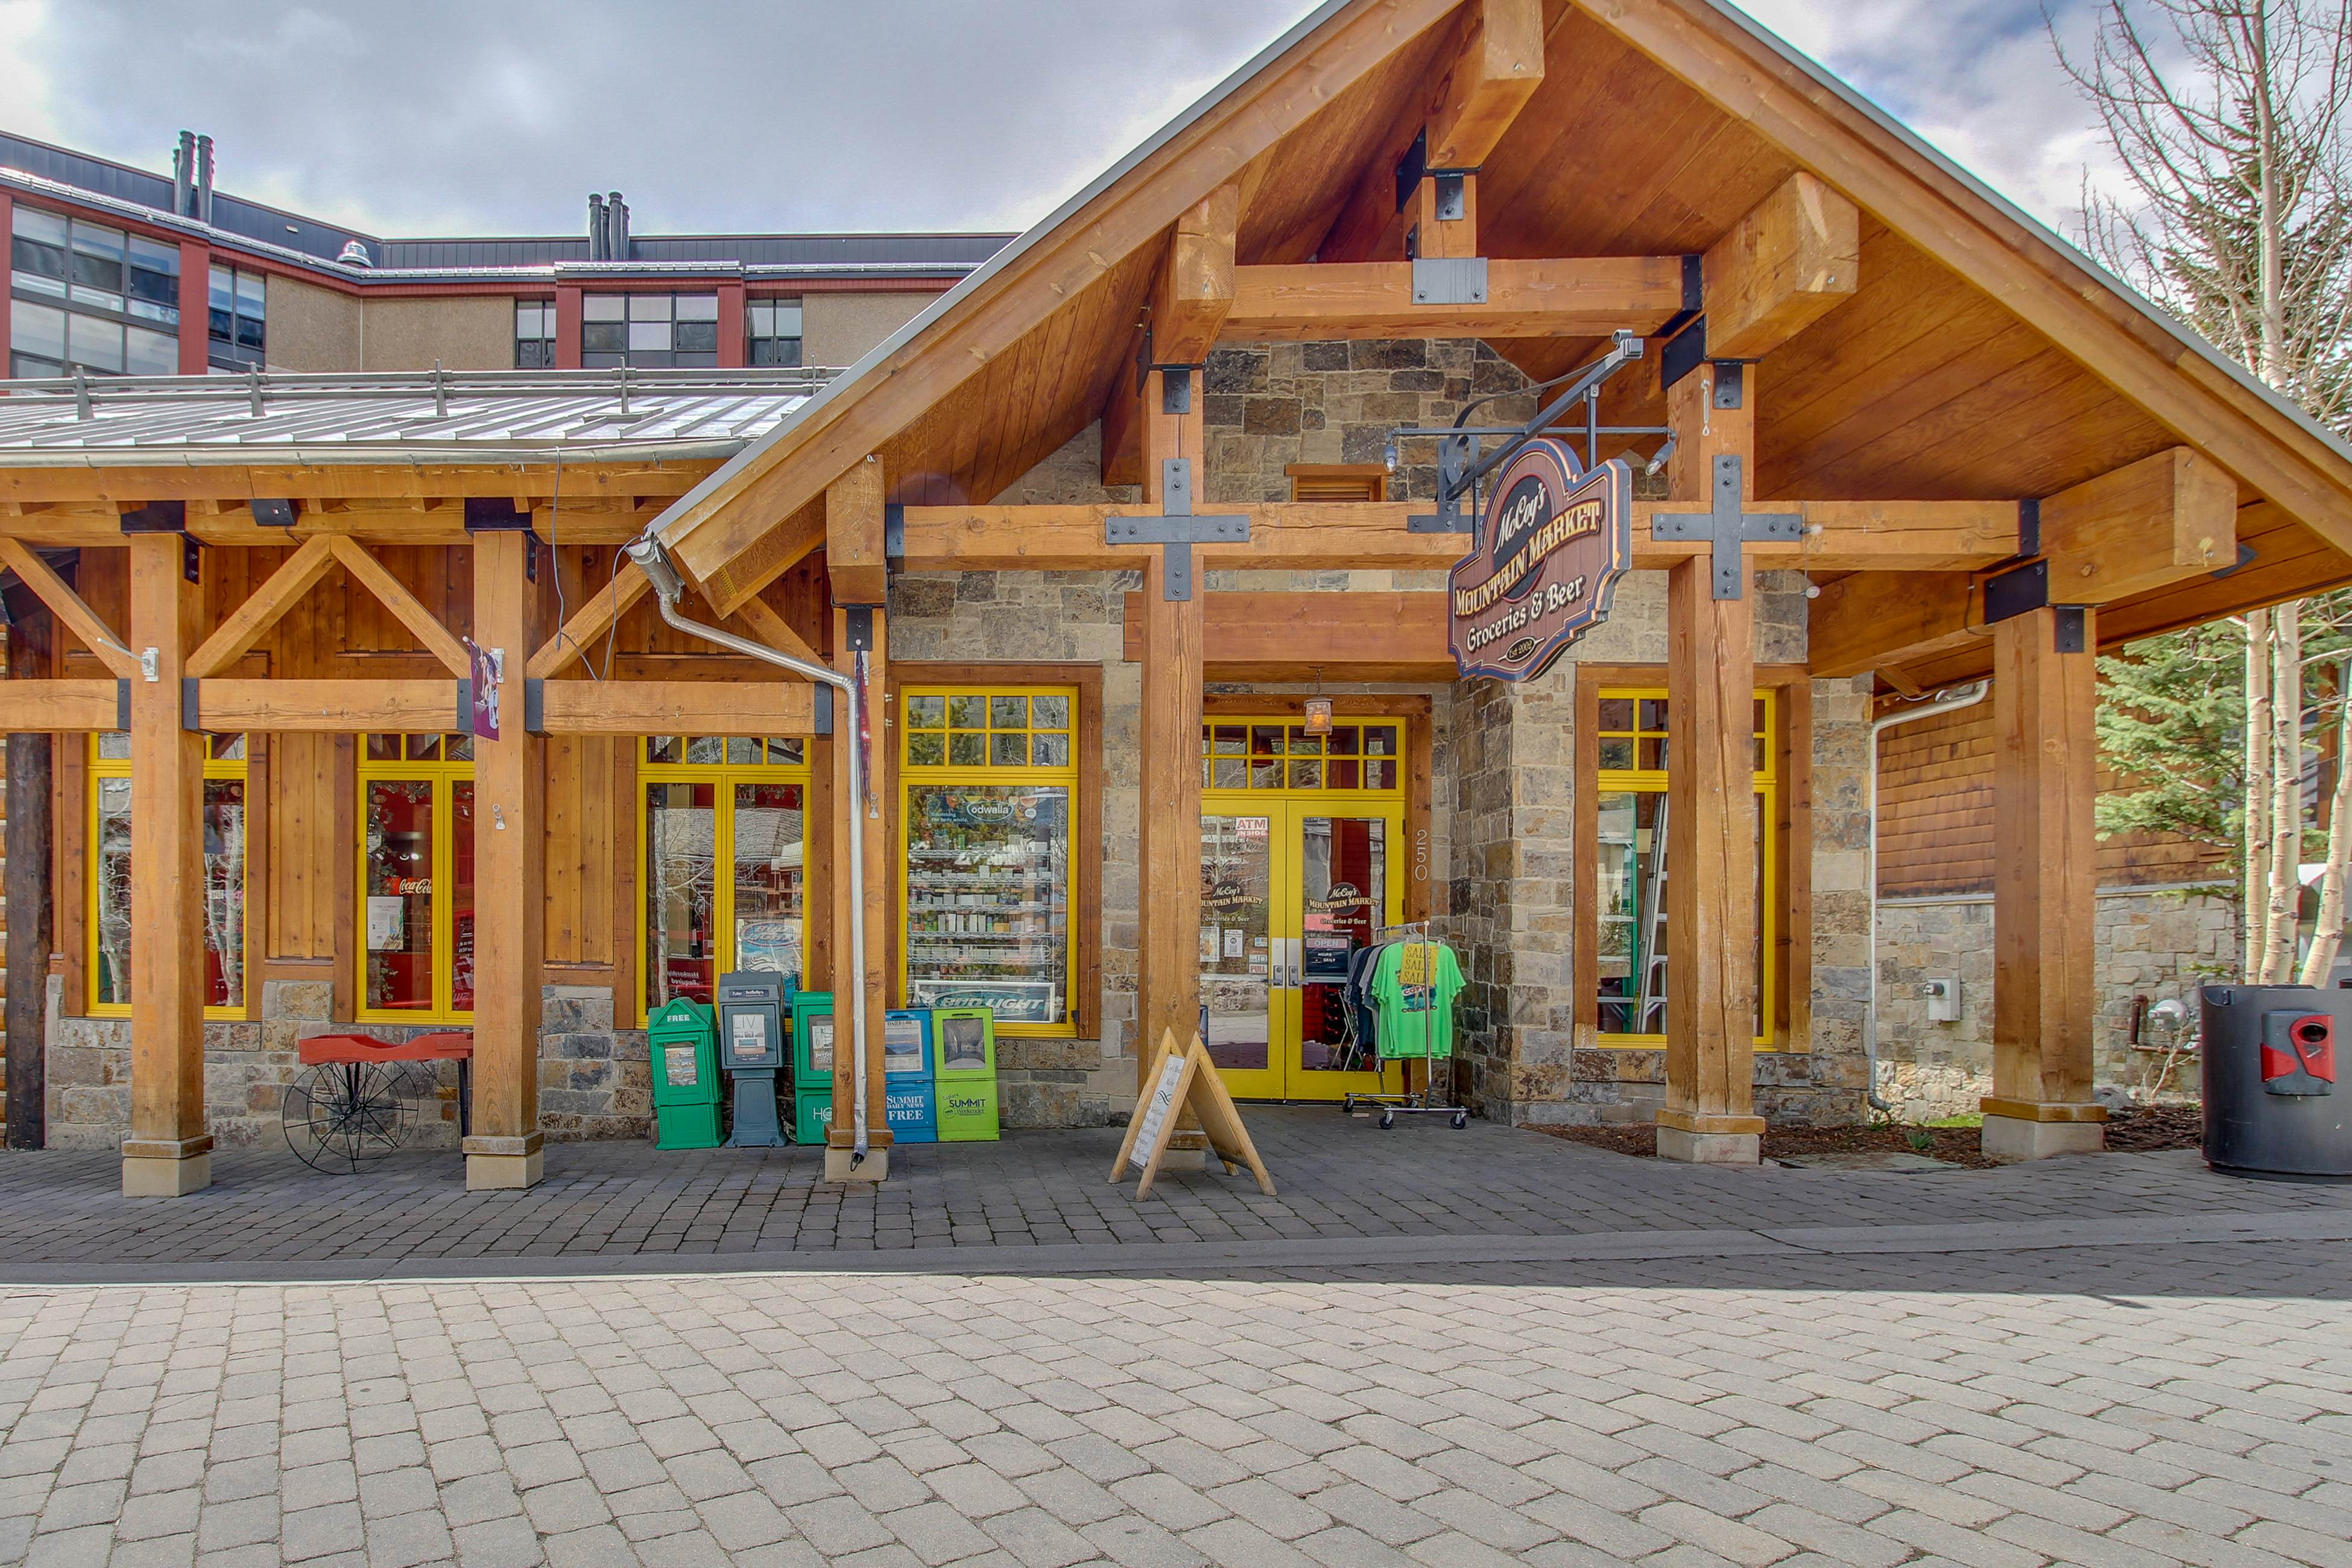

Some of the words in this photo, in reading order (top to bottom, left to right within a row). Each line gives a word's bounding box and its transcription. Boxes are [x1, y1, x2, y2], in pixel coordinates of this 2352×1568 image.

[1494, 482, 1546, 554] McCoy's
[1455, 546, 1527, 616] MOUNTAIN
[1528, 501, 1601, 567] MARKET
[1467, 606, 1527, 652] Groceries
[1531, 592, 1543, 619] &
[1546, 575, 1584, 613] Beer
[971, 805, 1009, 814] odwalla
[1237, 820, 1266, 829] ATM
[1212, 886, 1241, 897] McCoy's
[1329, 887, 1357, 899] McCoy's
[1201, 897, 1231, 907] OUNTAIN
[1232, 896, 1263, 905] MARKET
[1309, 899, 1347, 909] MOUNTAIN
[1348, 897, 1380, 906] MARKET
[1404, 971, 1425, 983] SAL
[940, 997, 983, 1008] BUD
[985, 998, 1045, 1010] LIGHT
[733, 1016, 756, 1029] LIV
[886, 1095, 923, 1104] SUMMIT
[949, 1098, 986, 1107] SUMMIT
[888, 1110, 924, 1121] FREE
